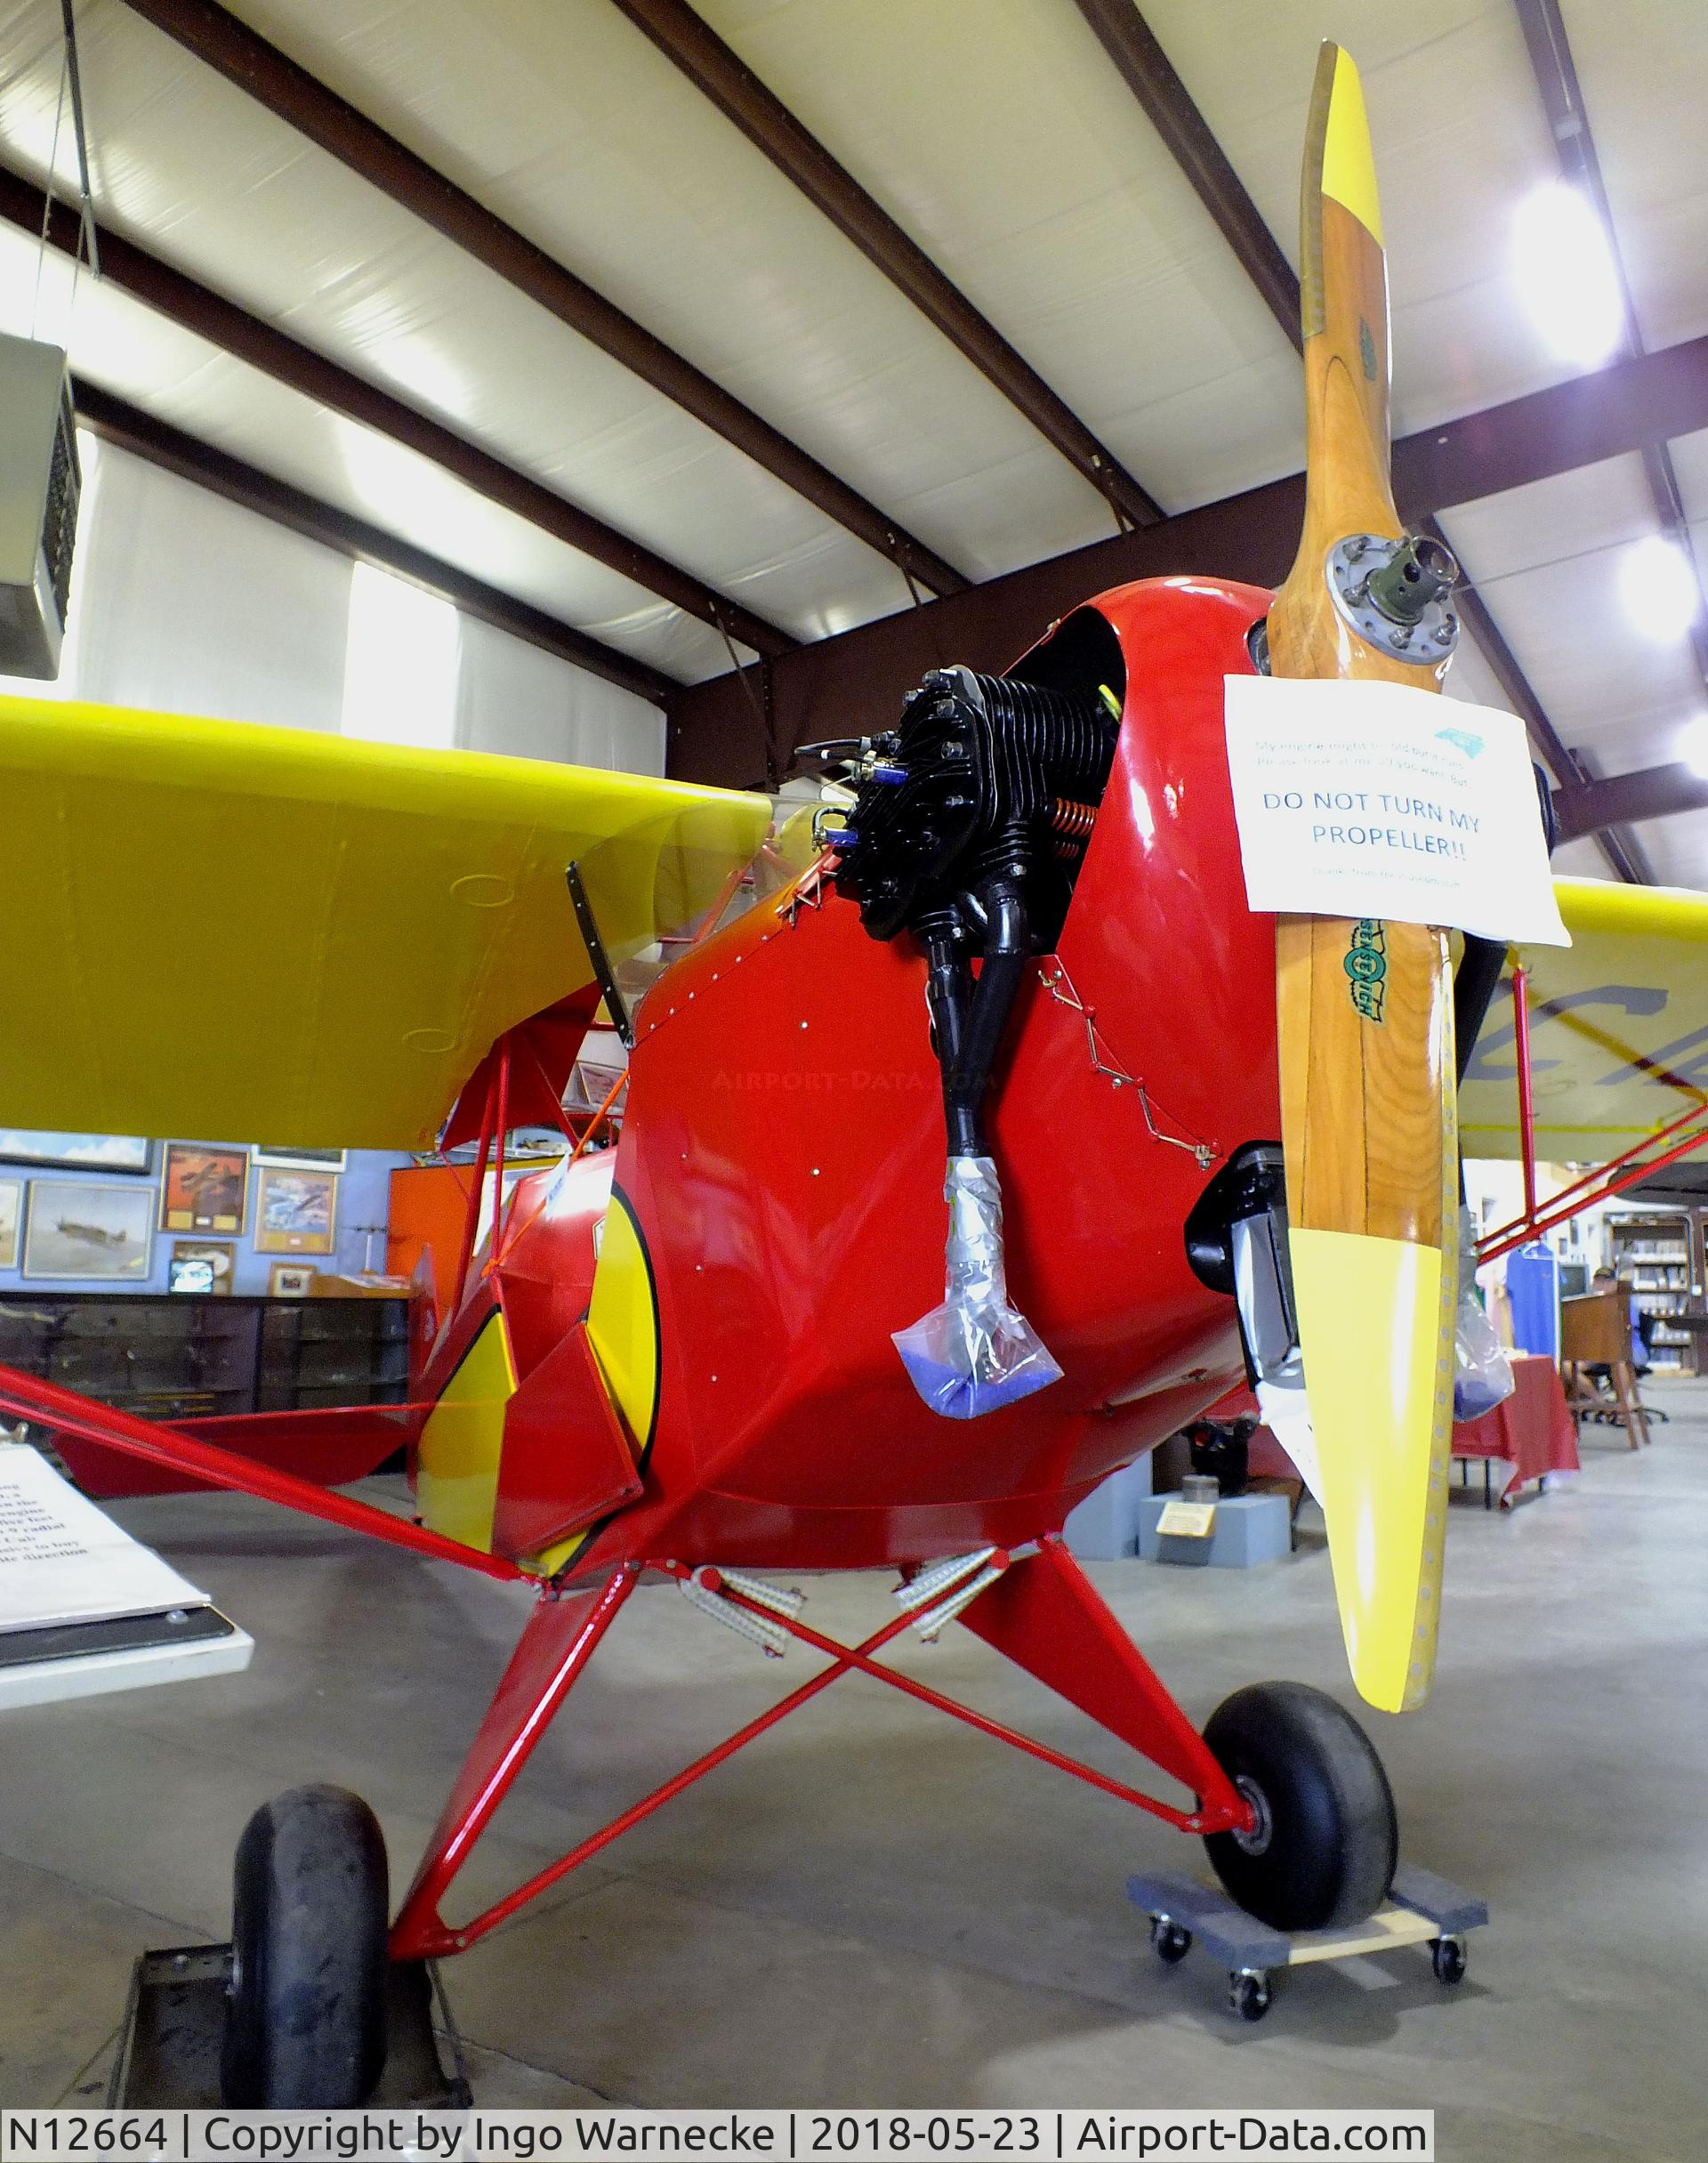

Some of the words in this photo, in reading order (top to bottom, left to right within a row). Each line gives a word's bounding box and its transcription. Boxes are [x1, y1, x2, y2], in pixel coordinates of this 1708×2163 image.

[1263, 792, 1303, 810] DO
[1313, 792, 1369, 811] NOT
[1378, 794, 1444, 823] TURN
[1448, 808, 1480, 834] MY
[1312, 825, 1467, 861] PROPELLER!!
